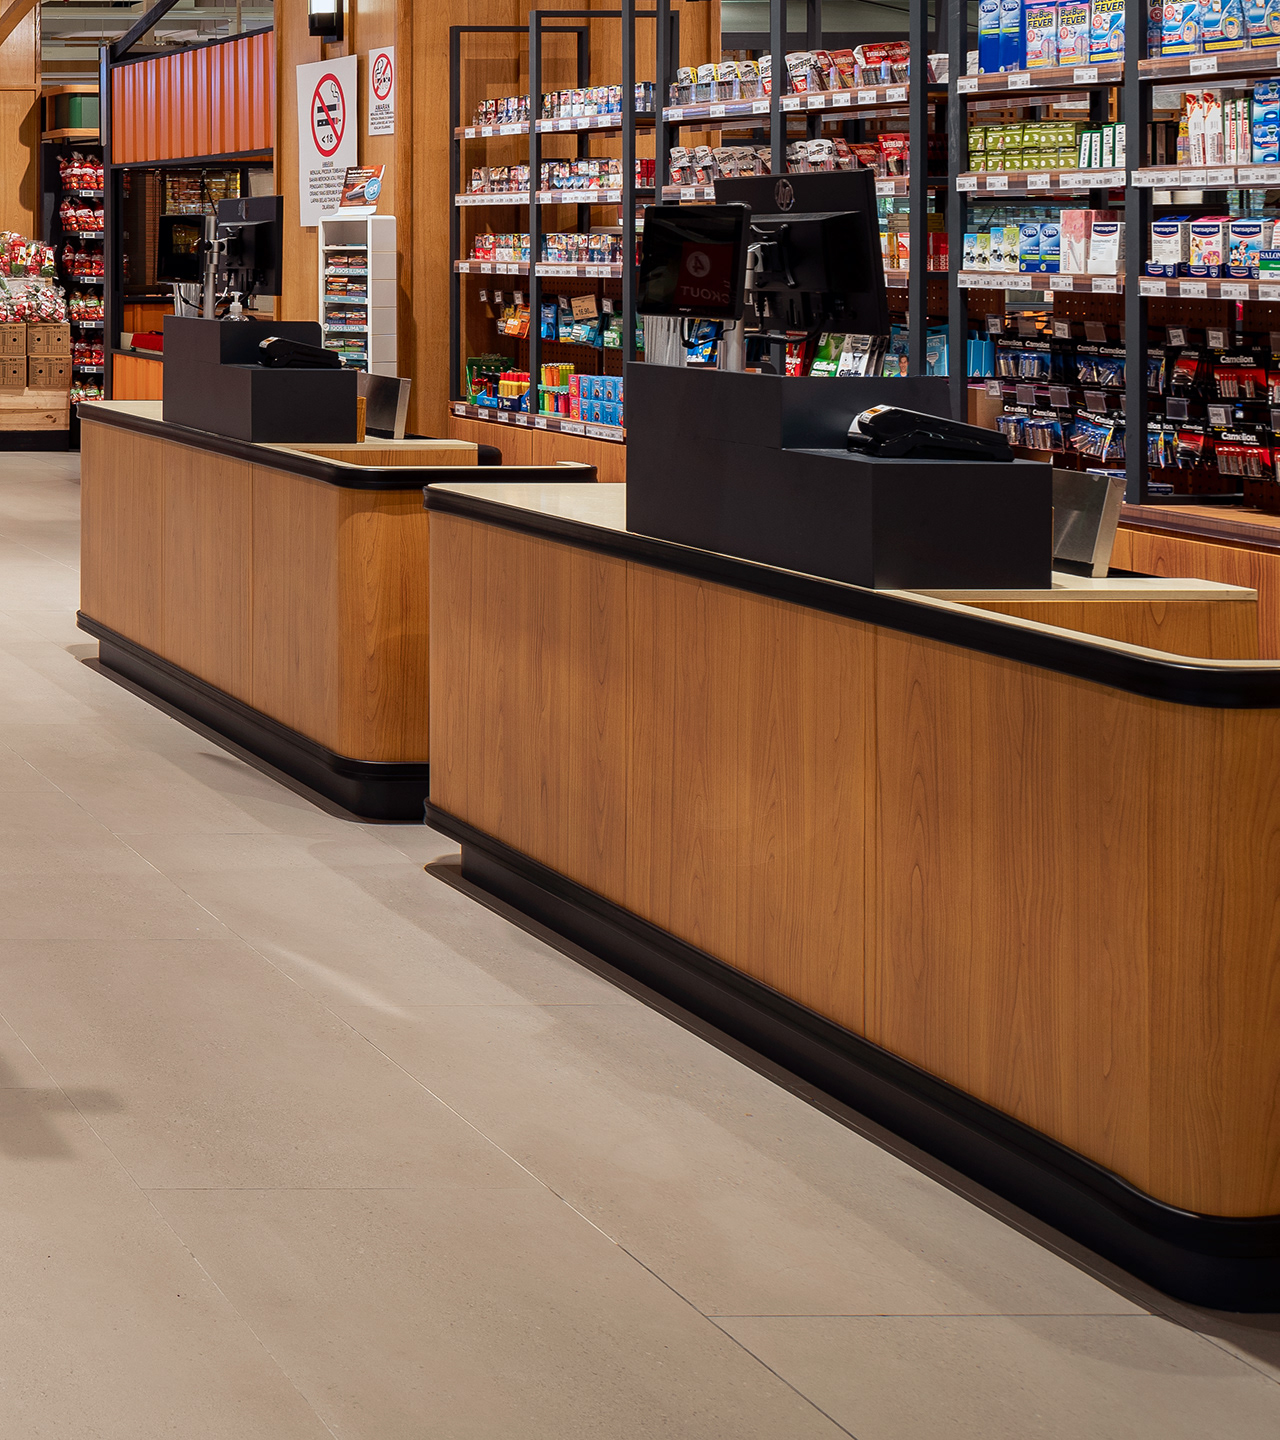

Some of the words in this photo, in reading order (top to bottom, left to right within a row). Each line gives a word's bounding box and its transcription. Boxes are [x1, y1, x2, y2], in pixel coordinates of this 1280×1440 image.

[1095, 1, 1124, 14] FEVER
[1028, 19, 1053, 29] FEVER
[1060, 16, 1086, 26] FEVER
[789, 57, 812, 71] Energizer
[812, 362, 837, 371] Gillette
[1221, 432, 1257, 441] Camelion
